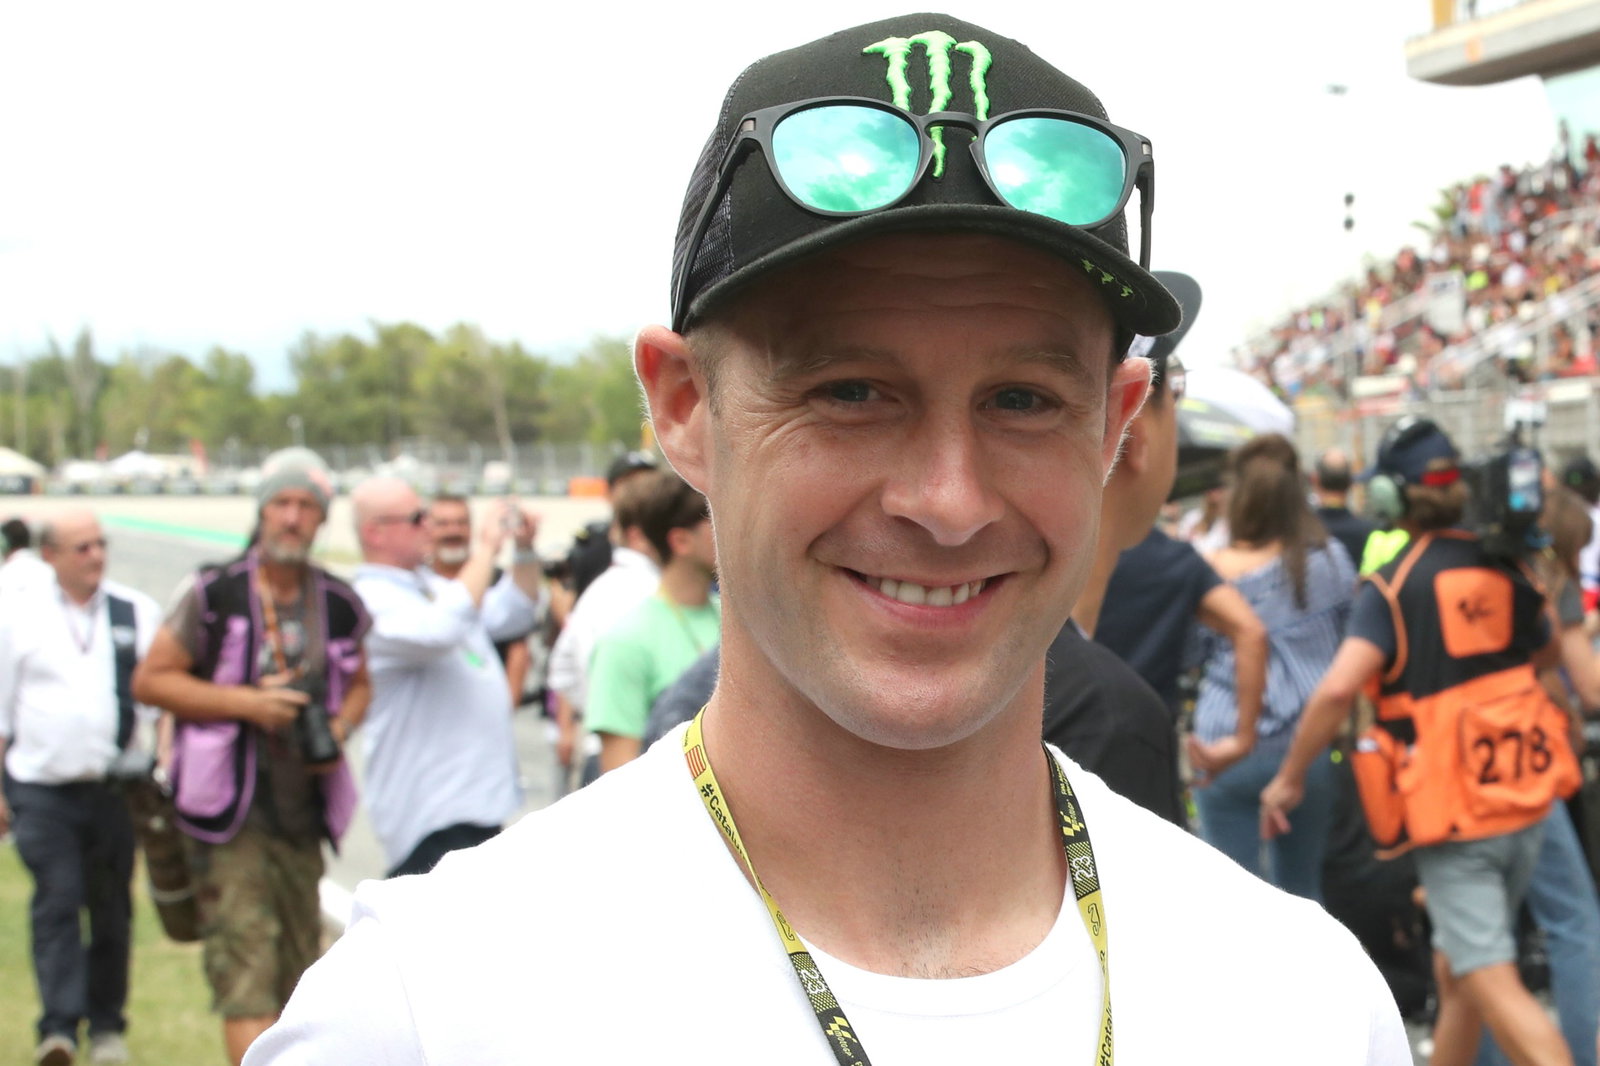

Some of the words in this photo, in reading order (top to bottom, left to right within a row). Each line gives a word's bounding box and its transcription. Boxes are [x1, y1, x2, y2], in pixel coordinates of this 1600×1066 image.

[1473, 725, 1552, 785] 278
[1072, 855, 1094, 881] 23
[801, 968, 828, 994] 23
